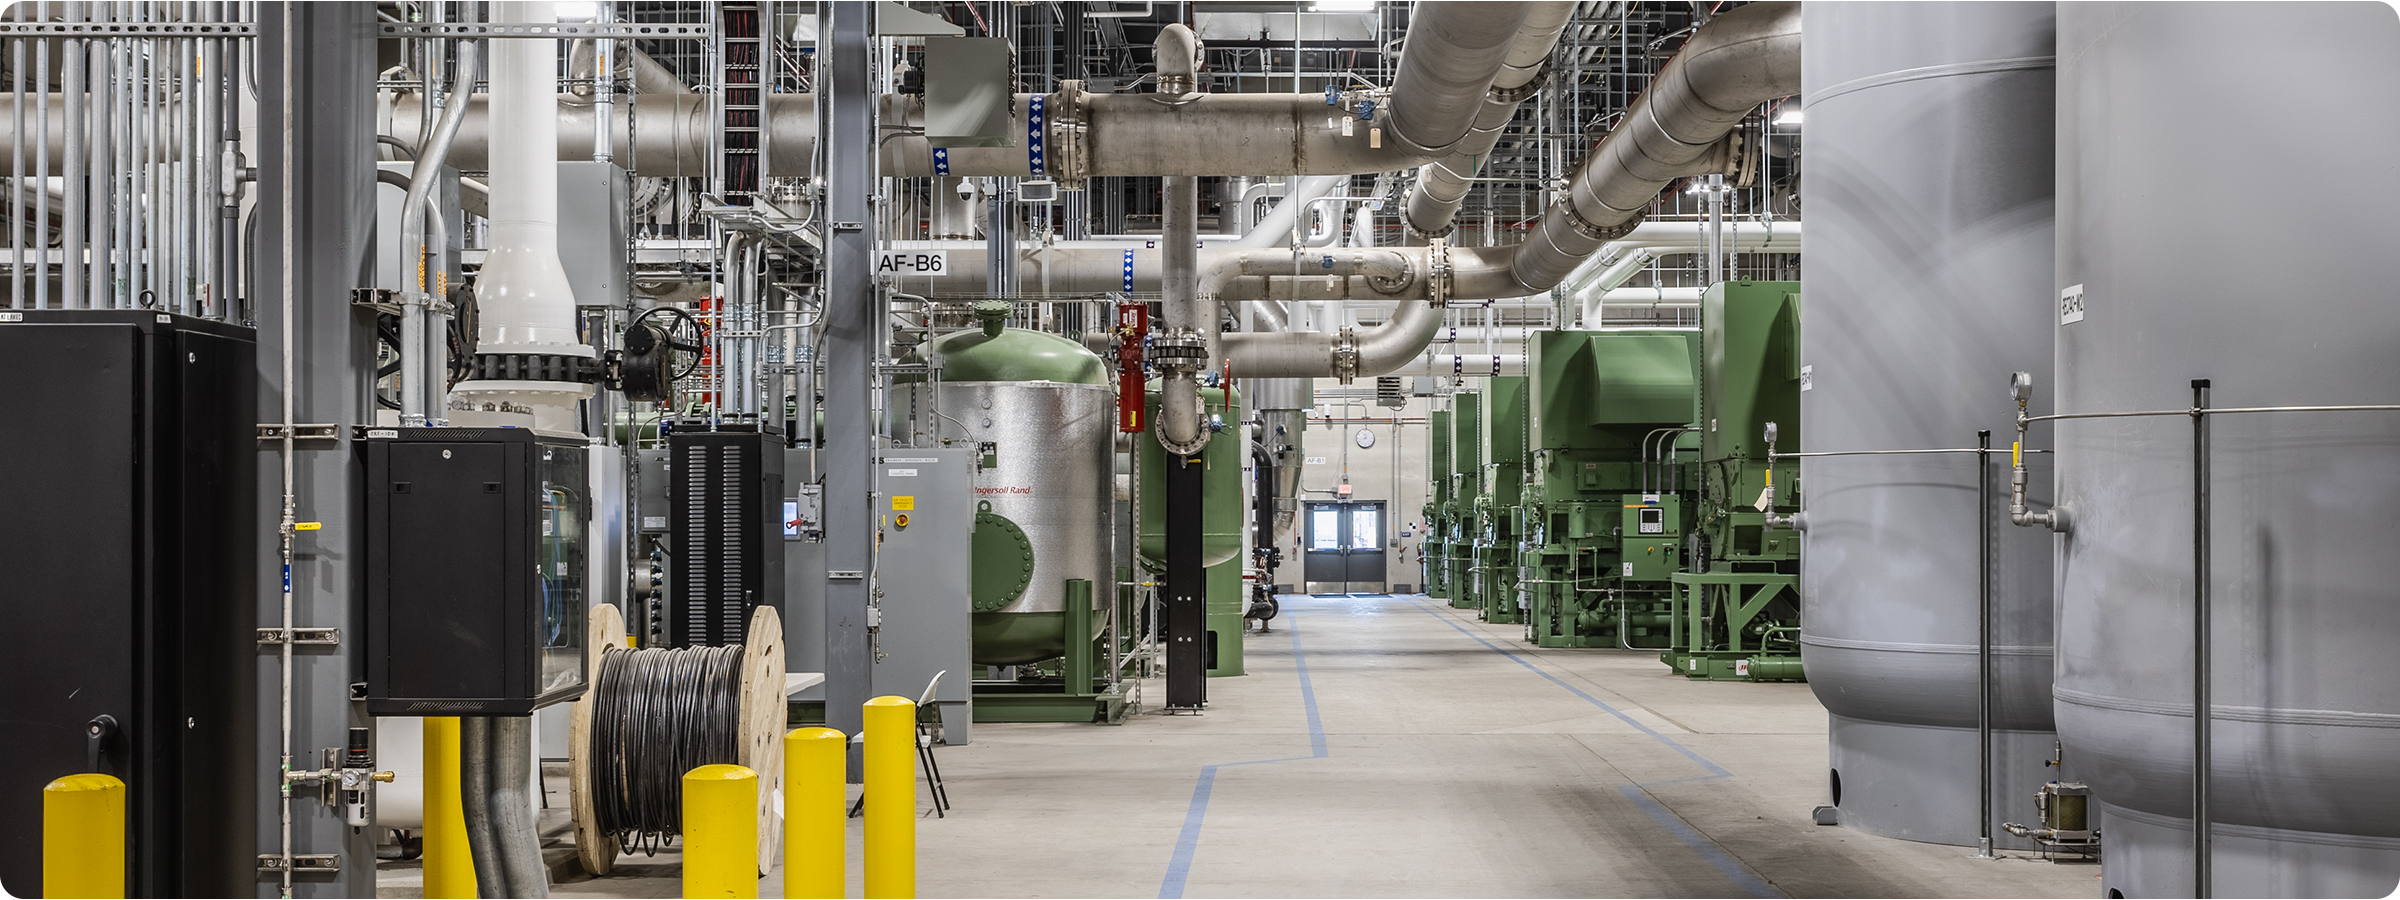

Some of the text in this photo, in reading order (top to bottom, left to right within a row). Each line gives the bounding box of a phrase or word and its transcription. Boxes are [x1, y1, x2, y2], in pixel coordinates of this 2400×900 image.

[879, 254, 942, 272] AF-B6
[974, 486, 1031, 496] Ingersoll Rand
